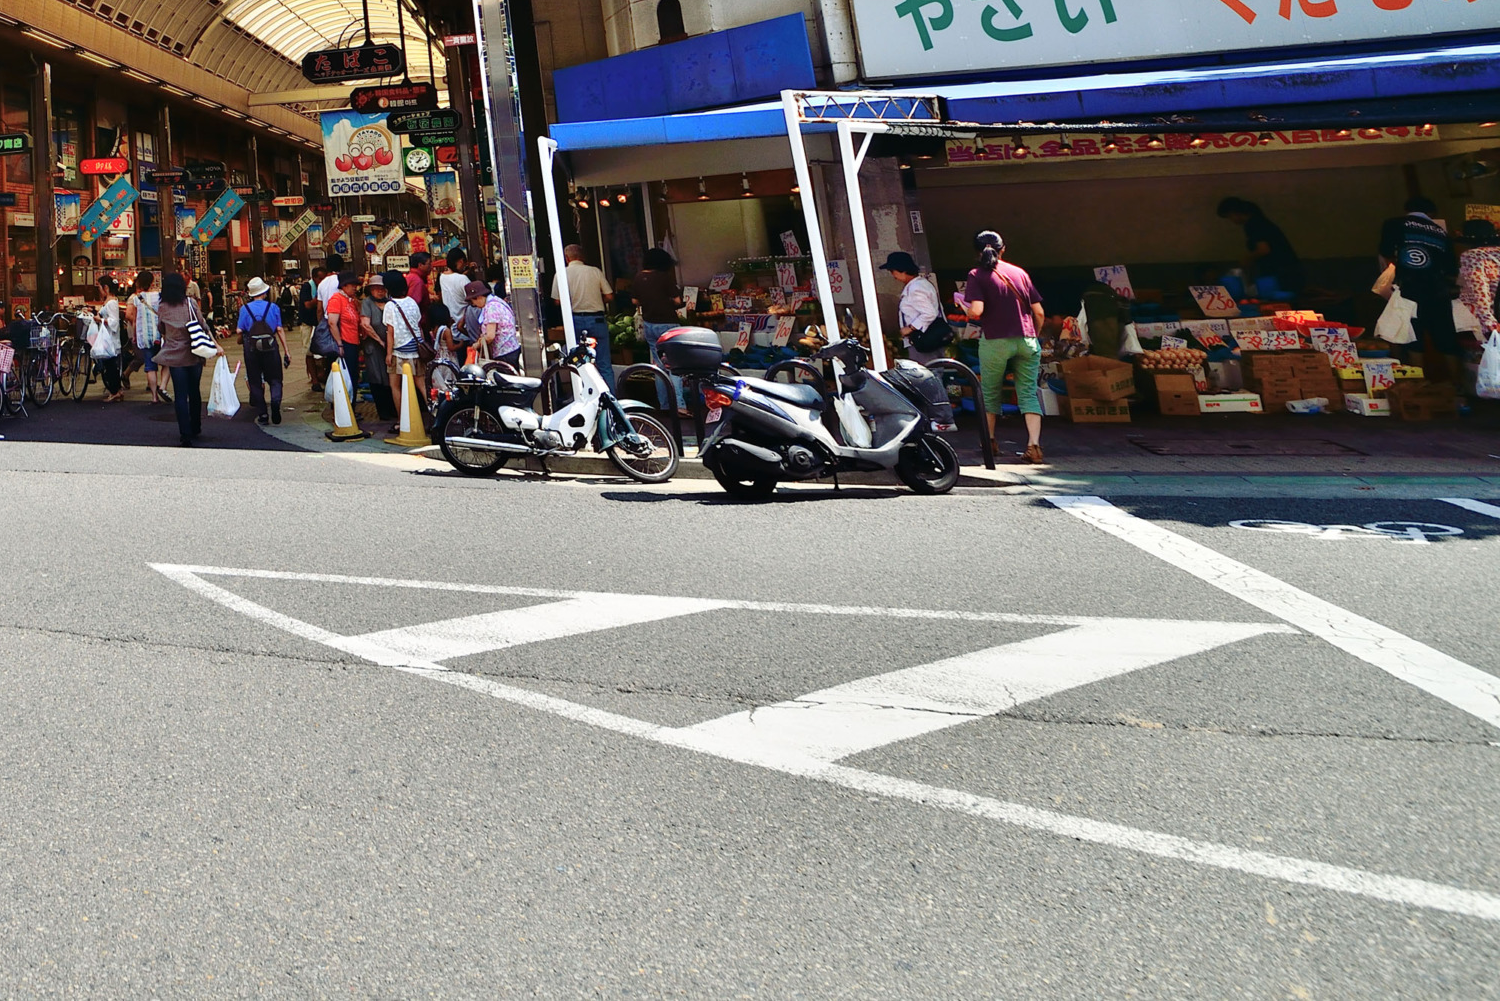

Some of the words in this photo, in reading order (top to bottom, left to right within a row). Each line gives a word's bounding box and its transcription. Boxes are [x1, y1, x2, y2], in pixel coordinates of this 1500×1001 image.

[314, 49, 389, 71] たばこ
[356, 128, 382, 139] ITAYADO
[1206, 292, 1235, 310] 250
